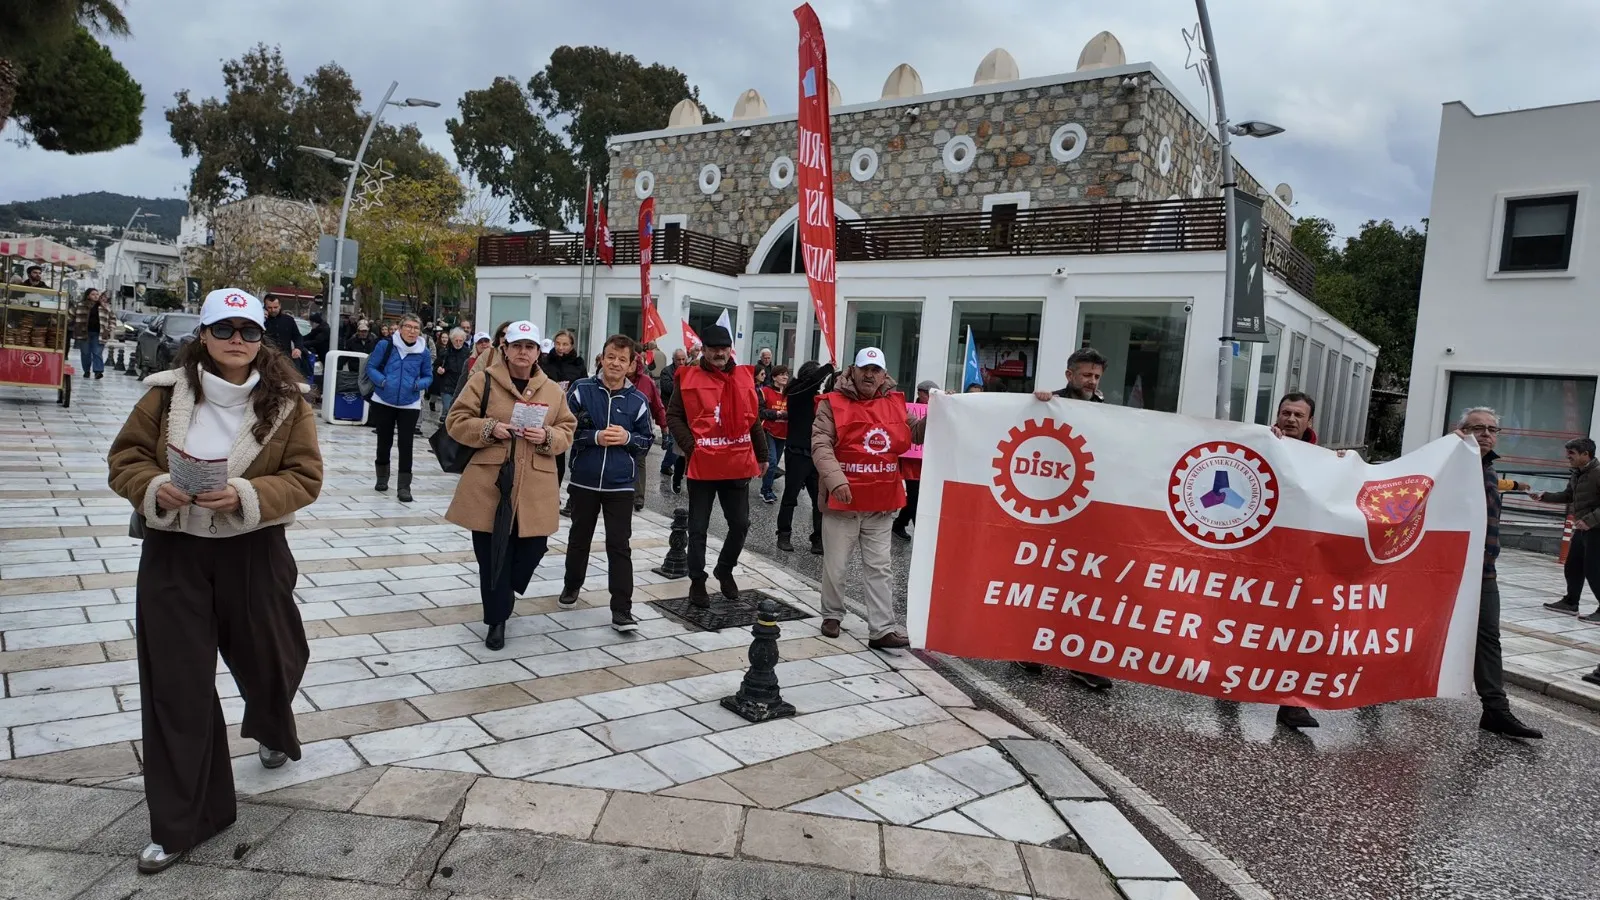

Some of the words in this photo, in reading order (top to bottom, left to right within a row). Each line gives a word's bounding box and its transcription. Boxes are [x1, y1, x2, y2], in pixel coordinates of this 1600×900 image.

[1014, 451, 1071, 480] DİSK
[1014, 538, 1108, 579] DİSK
[1114, 560, 1136, 583] /
[1143, 563, 1303, 609] EMEKLİ
[1332, 583, 1388, 611] SEN
[984, 580, 1203, 639] EMEKLİLER
[1213, 618, 1414, 656] SENDİKASI
[1032, 627, 1211, 684] BODRUM
[1220, 664, 1364, 699] ŞUBESİ
